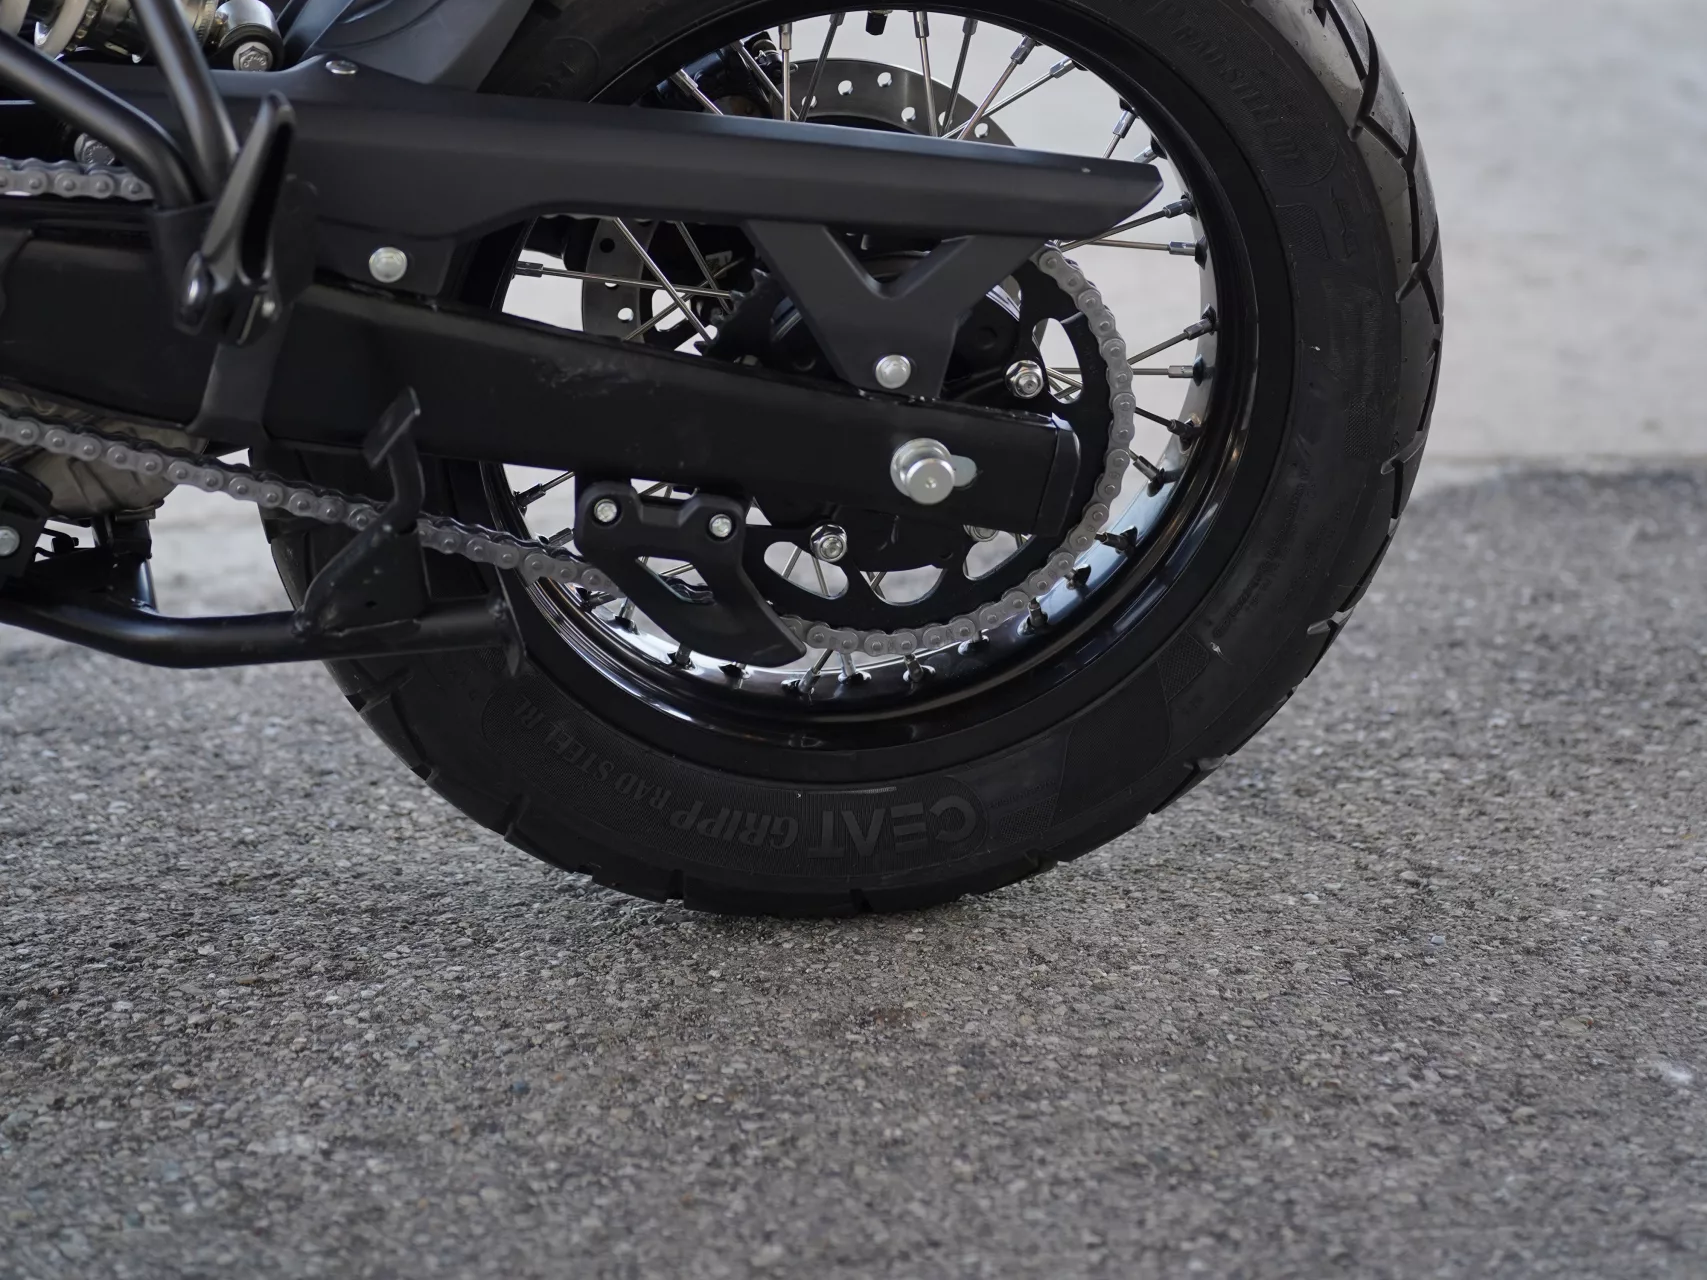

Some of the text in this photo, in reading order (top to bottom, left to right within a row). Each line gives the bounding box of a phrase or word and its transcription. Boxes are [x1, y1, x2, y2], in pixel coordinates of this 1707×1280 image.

[544, 719, 615, 781] STEEL
[612, 771, 671, 810] RAD
[669, 800, 798, 849] GRIPP
[808, 795, 977, 858] CEAT
